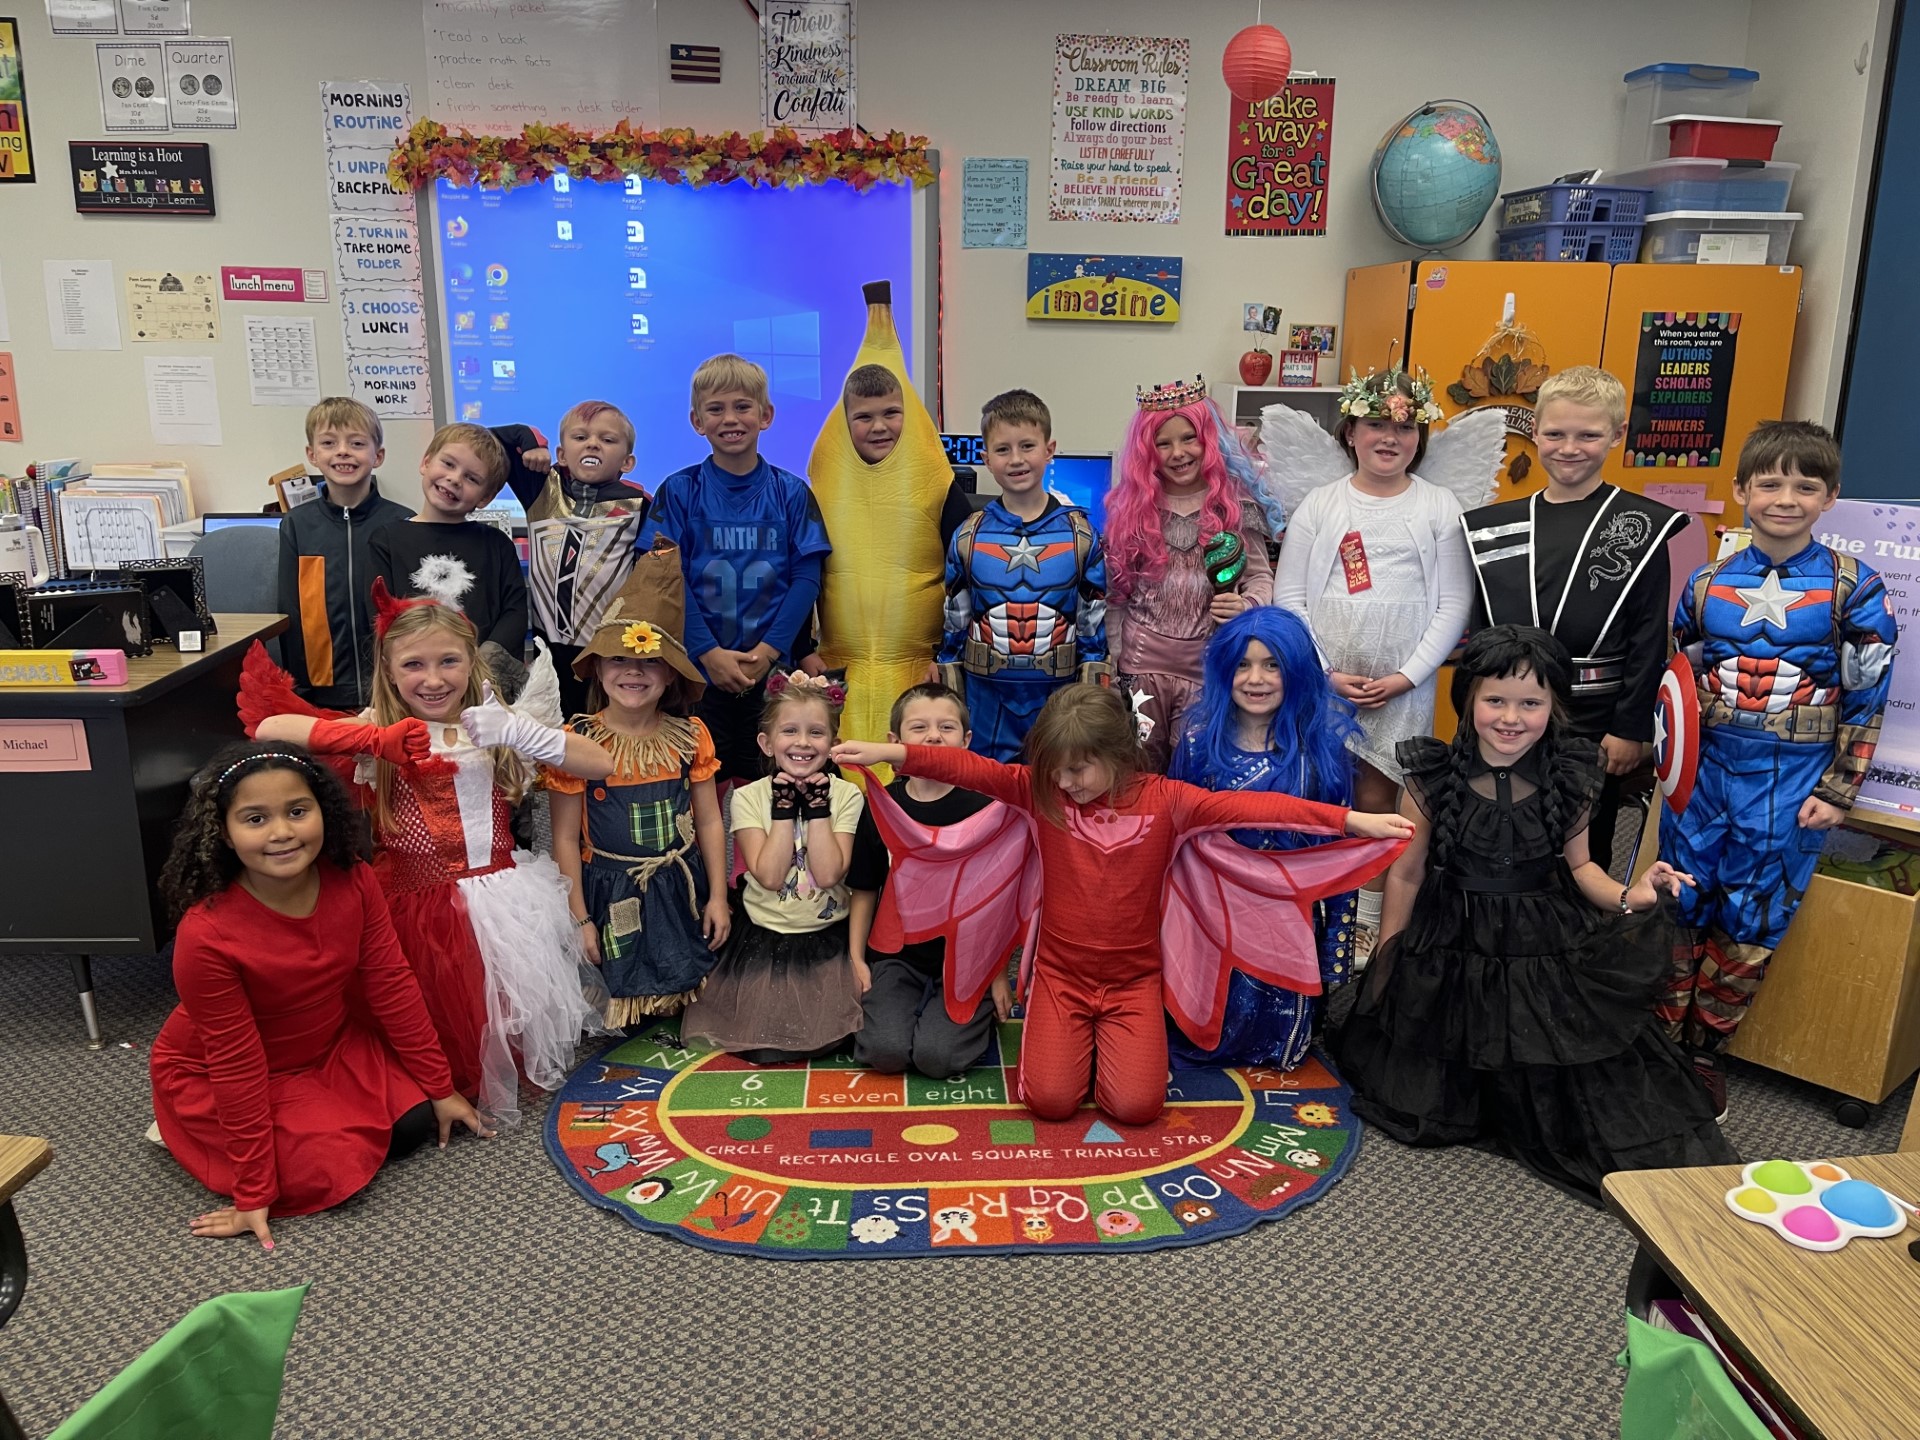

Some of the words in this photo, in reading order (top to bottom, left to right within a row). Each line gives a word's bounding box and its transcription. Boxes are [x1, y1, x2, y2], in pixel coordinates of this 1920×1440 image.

[771, 9, 833, 43] Throw
[440, 27, 472, 42] read
[497, 32, 528, 45] book
[115, 54, 146, 66] Dime
[172, 52, 224, 64] Quarter
[439, 51, 482, 69] practice
[489, 56, 518, 65] math
[525, 54, 551, 67] facts
[768, 41, 842, 72] Kindness
[1062, 47, 1138, 75] Classroom
[1142, 48, 1182, 78] Rules
[443, 77, 475, 89] clean
[488, 77, 514, 90] desk
[777, 70, 817, 85] around
[820, 69, 838, 86] like
[1075, 77, 1131, 93] DREAM
[1140, 80, 1167, 94] BIG
[773, 87, 847, 121] Confetti
[1066, 91, 1079, 102] Be
[1085, 93, 1118, 106] ready
[1124, 94, 1136, 104] to
[1141, 94, 1174, 106] learn
[1247, 88, 1318, 119] Make
[447, 97, 481, 112] finish
[490, 100, 548, 117] something
[577, 100, 602, 114] desk
[612, 101, 643, 113] folder
[1065, 106, 1088, 117] USE
[1093, 106, 1125, 119] KIND
[1129, 107, 1174, 120] WORDS
[1070, 117, 1107, 131] Follow
[1109, 120, 1167, 133] directions
[1063, 132, 1104, 146] Always
[1107, 133, 1118, 143] do
[1121, 136, 1147, 147] your
[1149, 134, 1173, 145] best
[1254, 120, 1316, 148] way
[91, 147, 137, 167] Learning
[139, 148, 147, 162] is
[148, 153, 154, 162] a
[156, 148, 183, 163] Hoot
[1080, 147, 1107, 159] LISTEN
[1110, 147, 1155, 161] CAREFULLY
[1261, 144, 1284, 158] for
[1286, 146, 1296, 157] a
[337, 160, 346, 173] 1.
[348, 161, 387, 174] UNPA
[1060, 159, 1084, 171] Raise
[1087, 162, 1106, 173] your
[1108, 159, 1131, 172] hand
[1133, 163, 1144, 172] to
[1146, 162, 1173, 177] speak
[1230, 152, 1327, 189] Great
[1076, 173, 1094, 184] Be
[1100, 176, 1108, 184] a
[1113, 174, 1158, 185] friend
[337, 182, 408, 195] BACKPAC
[1064, 184, 1103, 195] BELIEVE
[1106, 185, 1116, 195] IN
[1119, 186, 1167, 197] YOURSELF
[101, 192, 121, 204] Live
[130, 193, 158, 207] Laugh
[168, 193, 196, 204] Learn
[1060, 195, 1075, 206] Leave
[1098, 197, 1122, 208] SPARKLE
[1123, 198, 1149, 209] wherever
[1150, 200, 1161, 210] you
[1247, 182, 1323, 225] day!
[346, 227, 357, 238] 2.
[359, 227, 393, 238] TURN
[395, 228, 408, 238] IN
[231, 275, 261, 291] lunch
[264, 282, 294, 291] menu
[348, 302, 360, 314] 3.
[1043, 287, 1166, 317] imagine
[362, 322, 409, 334] LUNCH
[1683, 331, 1698, 339] you
[1699, 330, 1720, 338] enter
[1654, 338, 1668, 346] this
[1290, 353, 1314, 364] TEACH
[1661, 348, 1713, 361] AUTHORS
[353, 365, 364, 375] 4.
[1660, 363, 1710, 375] LEADERS
[1655, 377, 1713, 390] SCHOLARS
[375, 394, 408, 404] WORK
[1650, 391, 1713, 404] EXPLORERS
[1506, 406, 1534, 422] LEAVE
[1652, 406, 1708, 418] CREATORS
[1650, 420, 1705, 432] THINKERS
[1637, 434, 1714, 449] IMPORTANT
[712, 527, 778, 551] ANTHR
[1820, 532, 1866, 553] the
[1884, 571, 1912, 581] went
[3, 739, 48, 750] Michael
[645, 1049, 697, 1070] Zz
[617, 1076, 663, 1100] Yy
[741, 1074, 763, 1091] 6
[845, 1072, 866, 1089] 7
[730, 1094, 768, 1107] six
[818, 1092, 899, 1104] seven
[925, 1084, 999, 1104] eight
[609, 1106, 649, 1139] Xx
[1162, 1135, 1214, 1145] STAR
[1252, 1123, 1308, 1157] Mm
[705, 1144, 775, 1155] CIRCLE
[908, 1151, 963, 1162] OVAL
[971, 1149, 1054, 1161] SQUARE
[1061, 1147, 1161, 1159] TRIANGLE
[779, 1152, 899, 1166] RECTANGLE
[1210, 1150, 1275, 1179] Nn
[675, 1170, 719, 1205] Vv
[1161, 1175, 1222, 1200] Oo
[729, 1184, 782, 1216] Uu
[960, 1191, 1008, 1218] Rr
[1028, 1186, 1089, 1223] Qq
[1103, 1184, 1159, 1211] Pp
[807, 1197, 847, 1225] Tt
[872, 1195, 928, 1222] Ss
